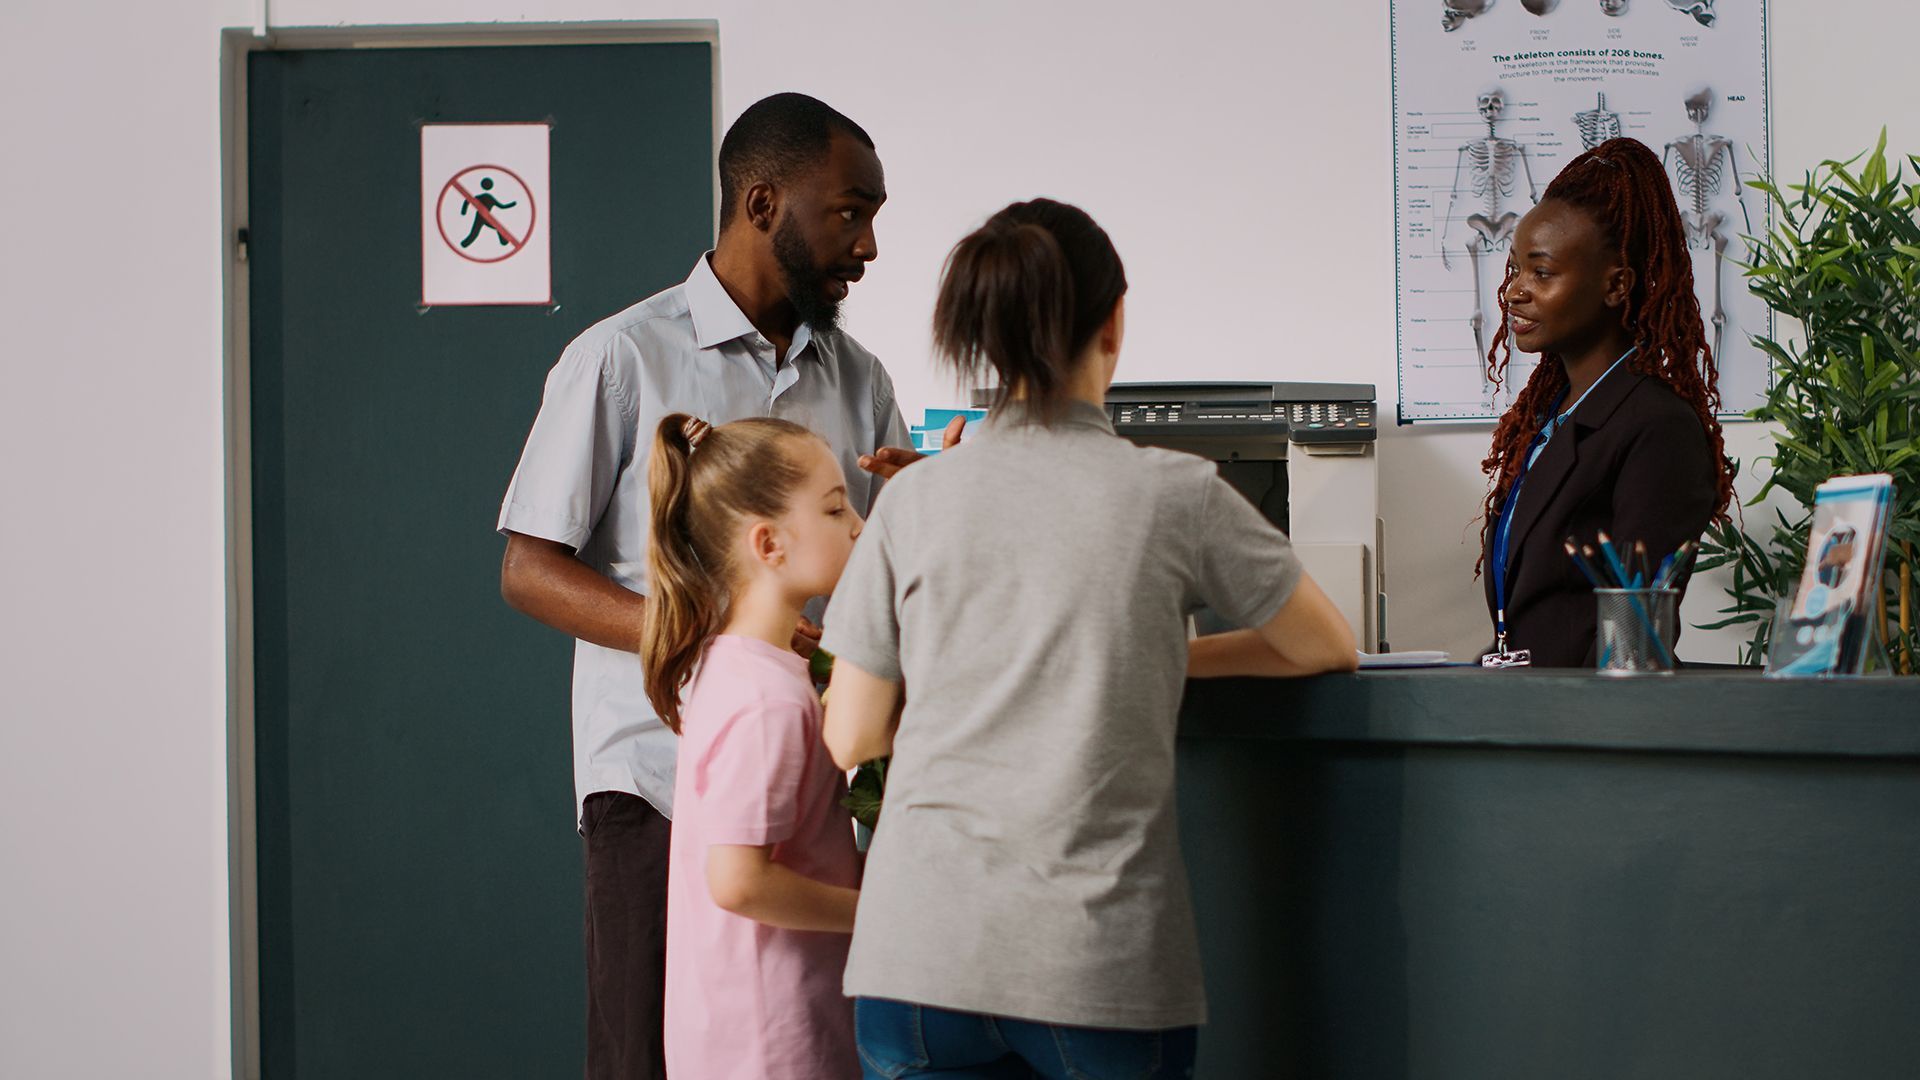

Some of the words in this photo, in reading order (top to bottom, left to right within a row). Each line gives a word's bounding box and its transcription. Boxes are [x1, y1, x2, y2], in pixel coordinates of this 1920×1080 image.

[1493, 55, 1511, 63] The
[1513, 51, 1555, 61] skeleton
[1557, 48, 1596, 57] consists
[1598, 48, 1609, 57] of
[1611, 49, 1631, 57] 206
[1633, 50, 1665, 60] bones.
[1518, 61, 1548, 69] skeleton
[1569, 58, 1607, 66] framework
[1625, 60, 1656, 68] provides
[1499, 70, 1531, 80] structure
[1591, 67, 1610, 75] body
[1626, 68, 1660, 77] facilitates
